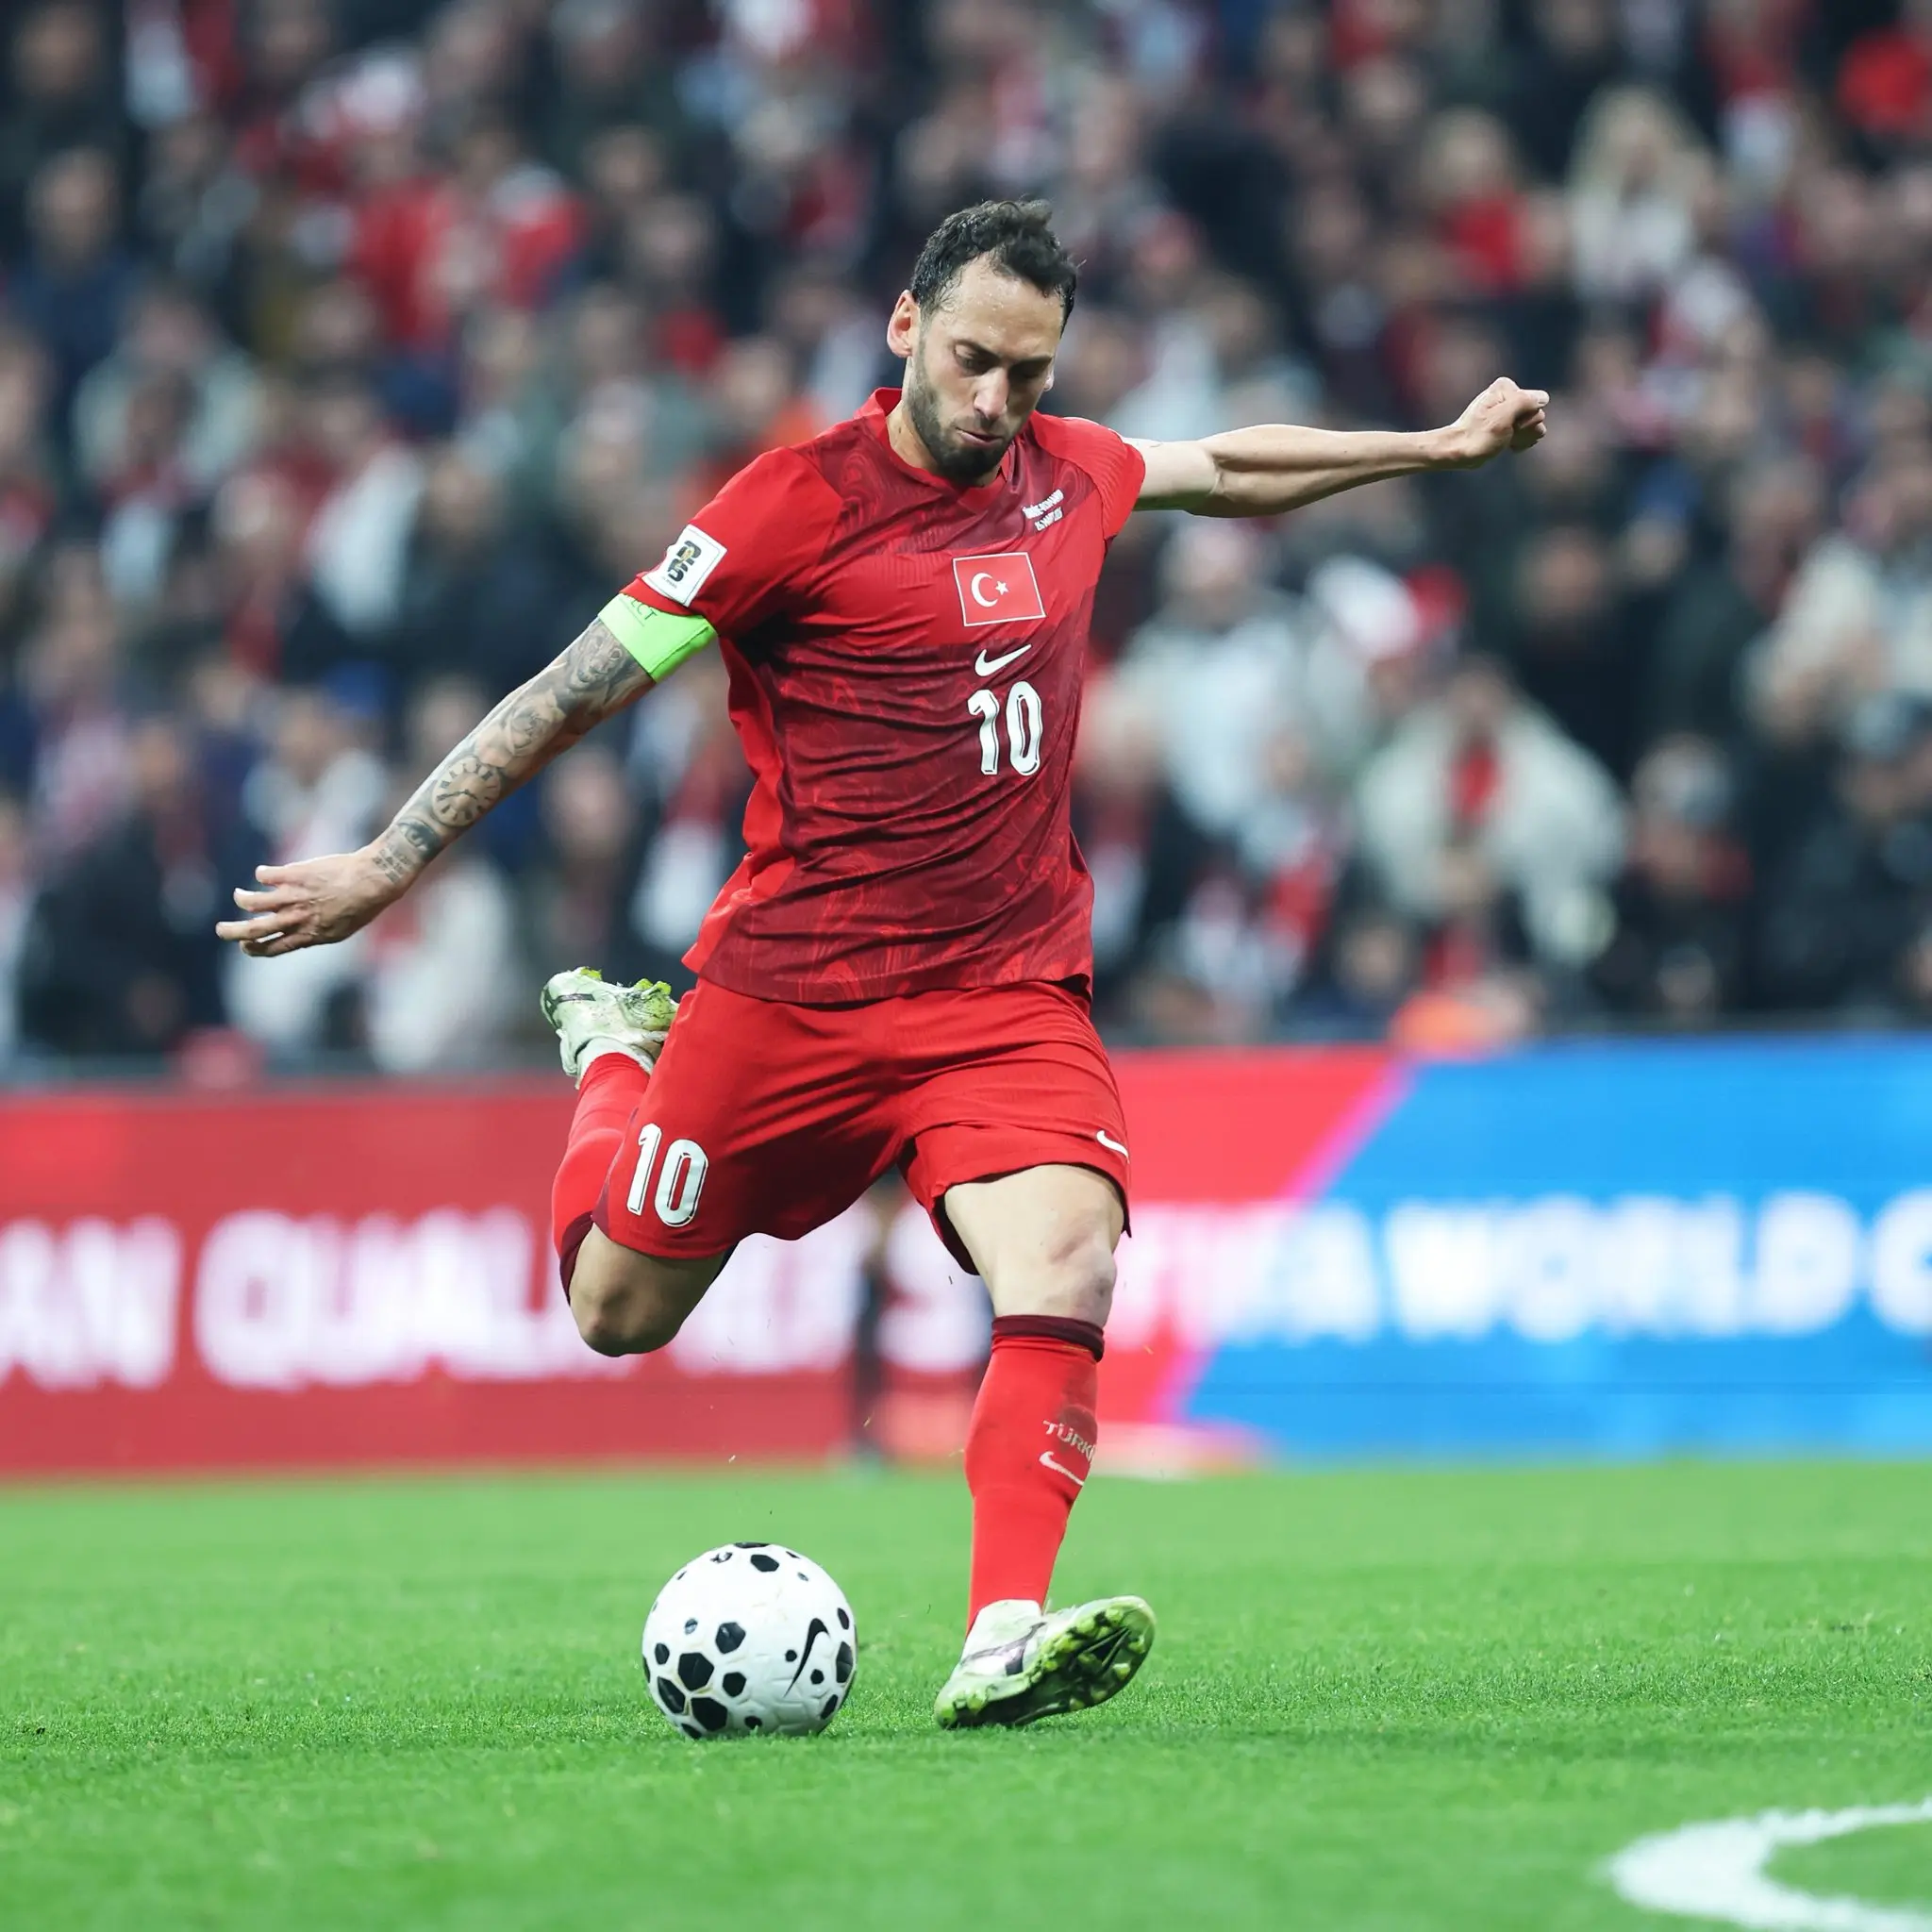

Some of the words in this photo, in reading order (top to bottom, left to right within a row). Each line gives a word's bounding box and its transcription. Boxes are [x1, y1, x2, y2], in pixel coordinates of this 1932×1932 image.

[967, 680, 1043, 776] 10
[626, 1123, 709, 1228] 10
[1380, 1192, 1865, 1343] WORLD
